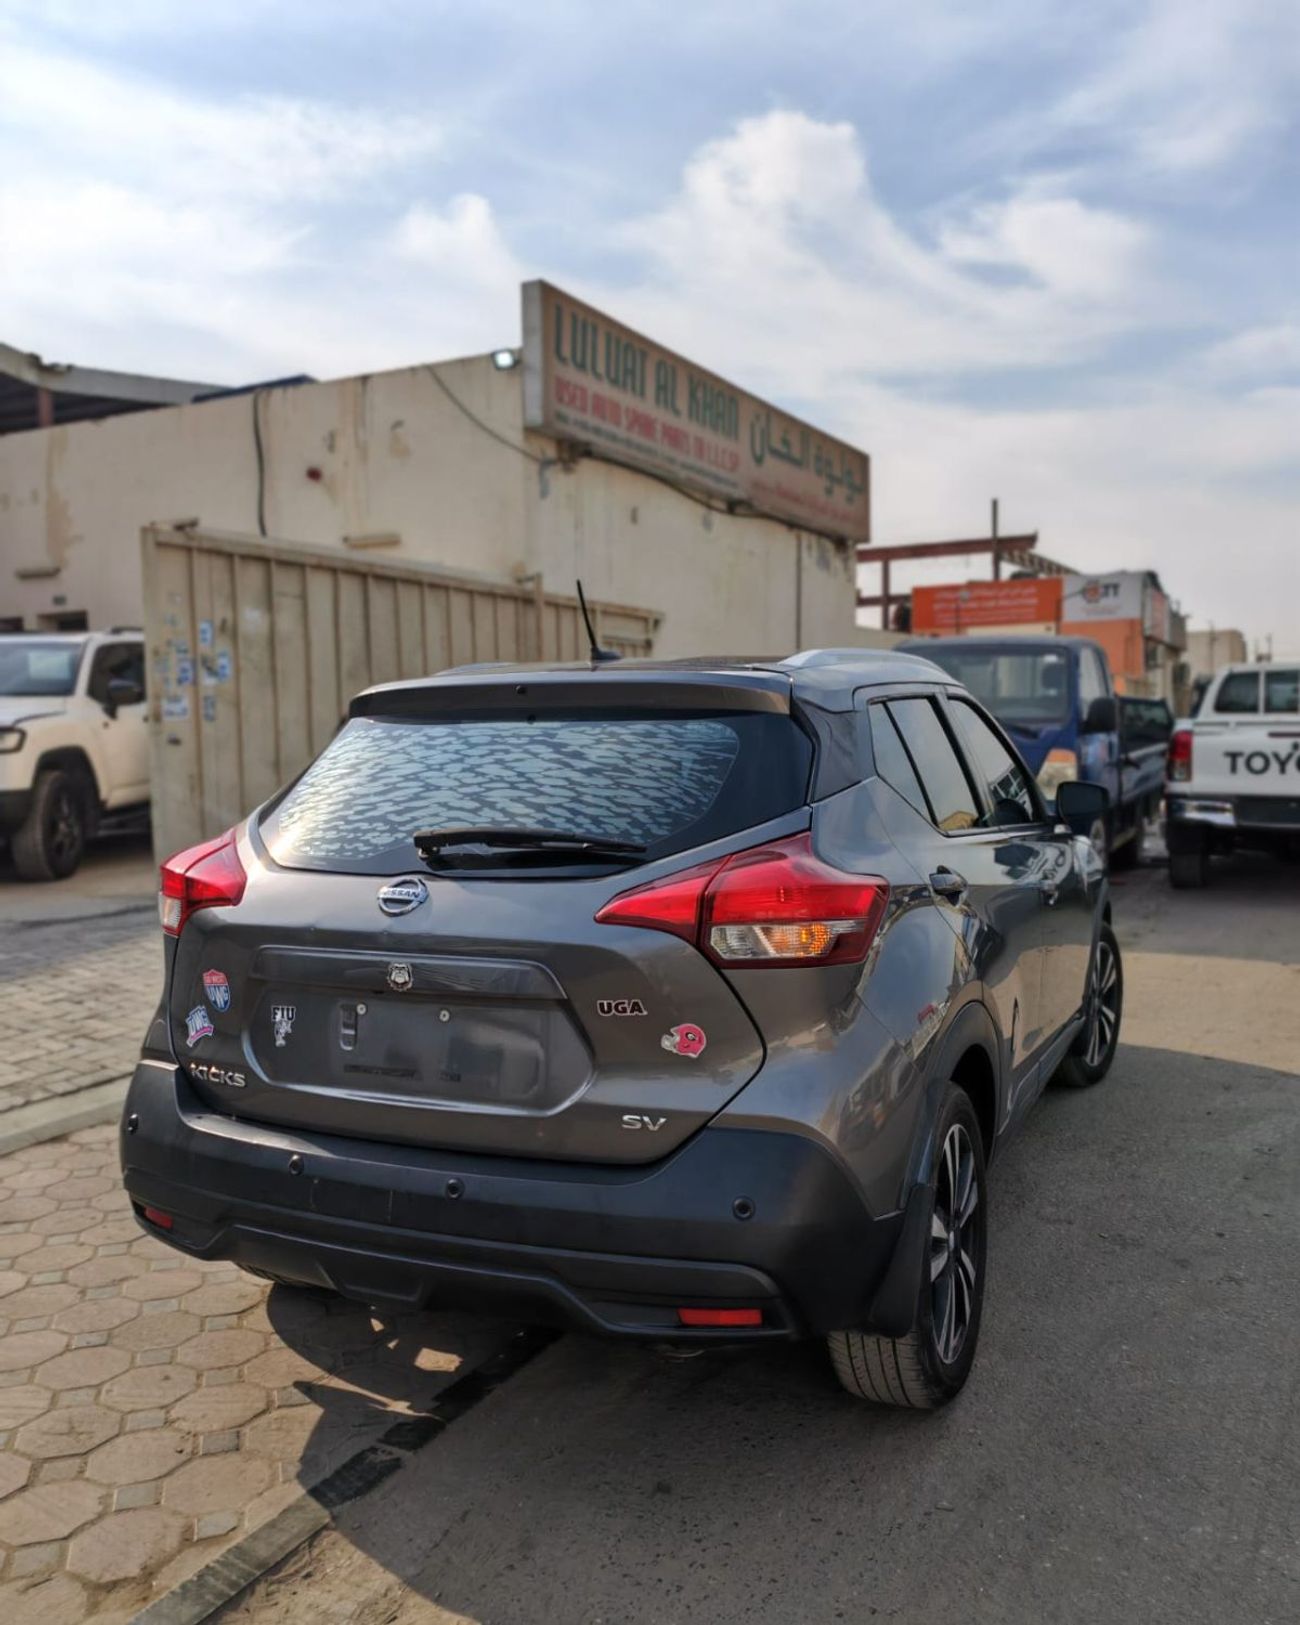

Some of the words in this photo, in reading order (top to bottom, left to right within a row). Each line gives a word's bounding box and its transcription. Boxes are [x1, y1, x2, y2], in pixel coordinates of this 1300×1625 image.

[554, 303, 646, 399] LULUAT
[655, 357, 681, 418] AL
[1223, 751, 1300, 775] TOY
[272, 1007, 296, 1021] FIU
[598, 1000, 646, 1016] UGA
[189, 1061, 246, 1088] KICKS
[621, 1115, 667, 1132] SV
